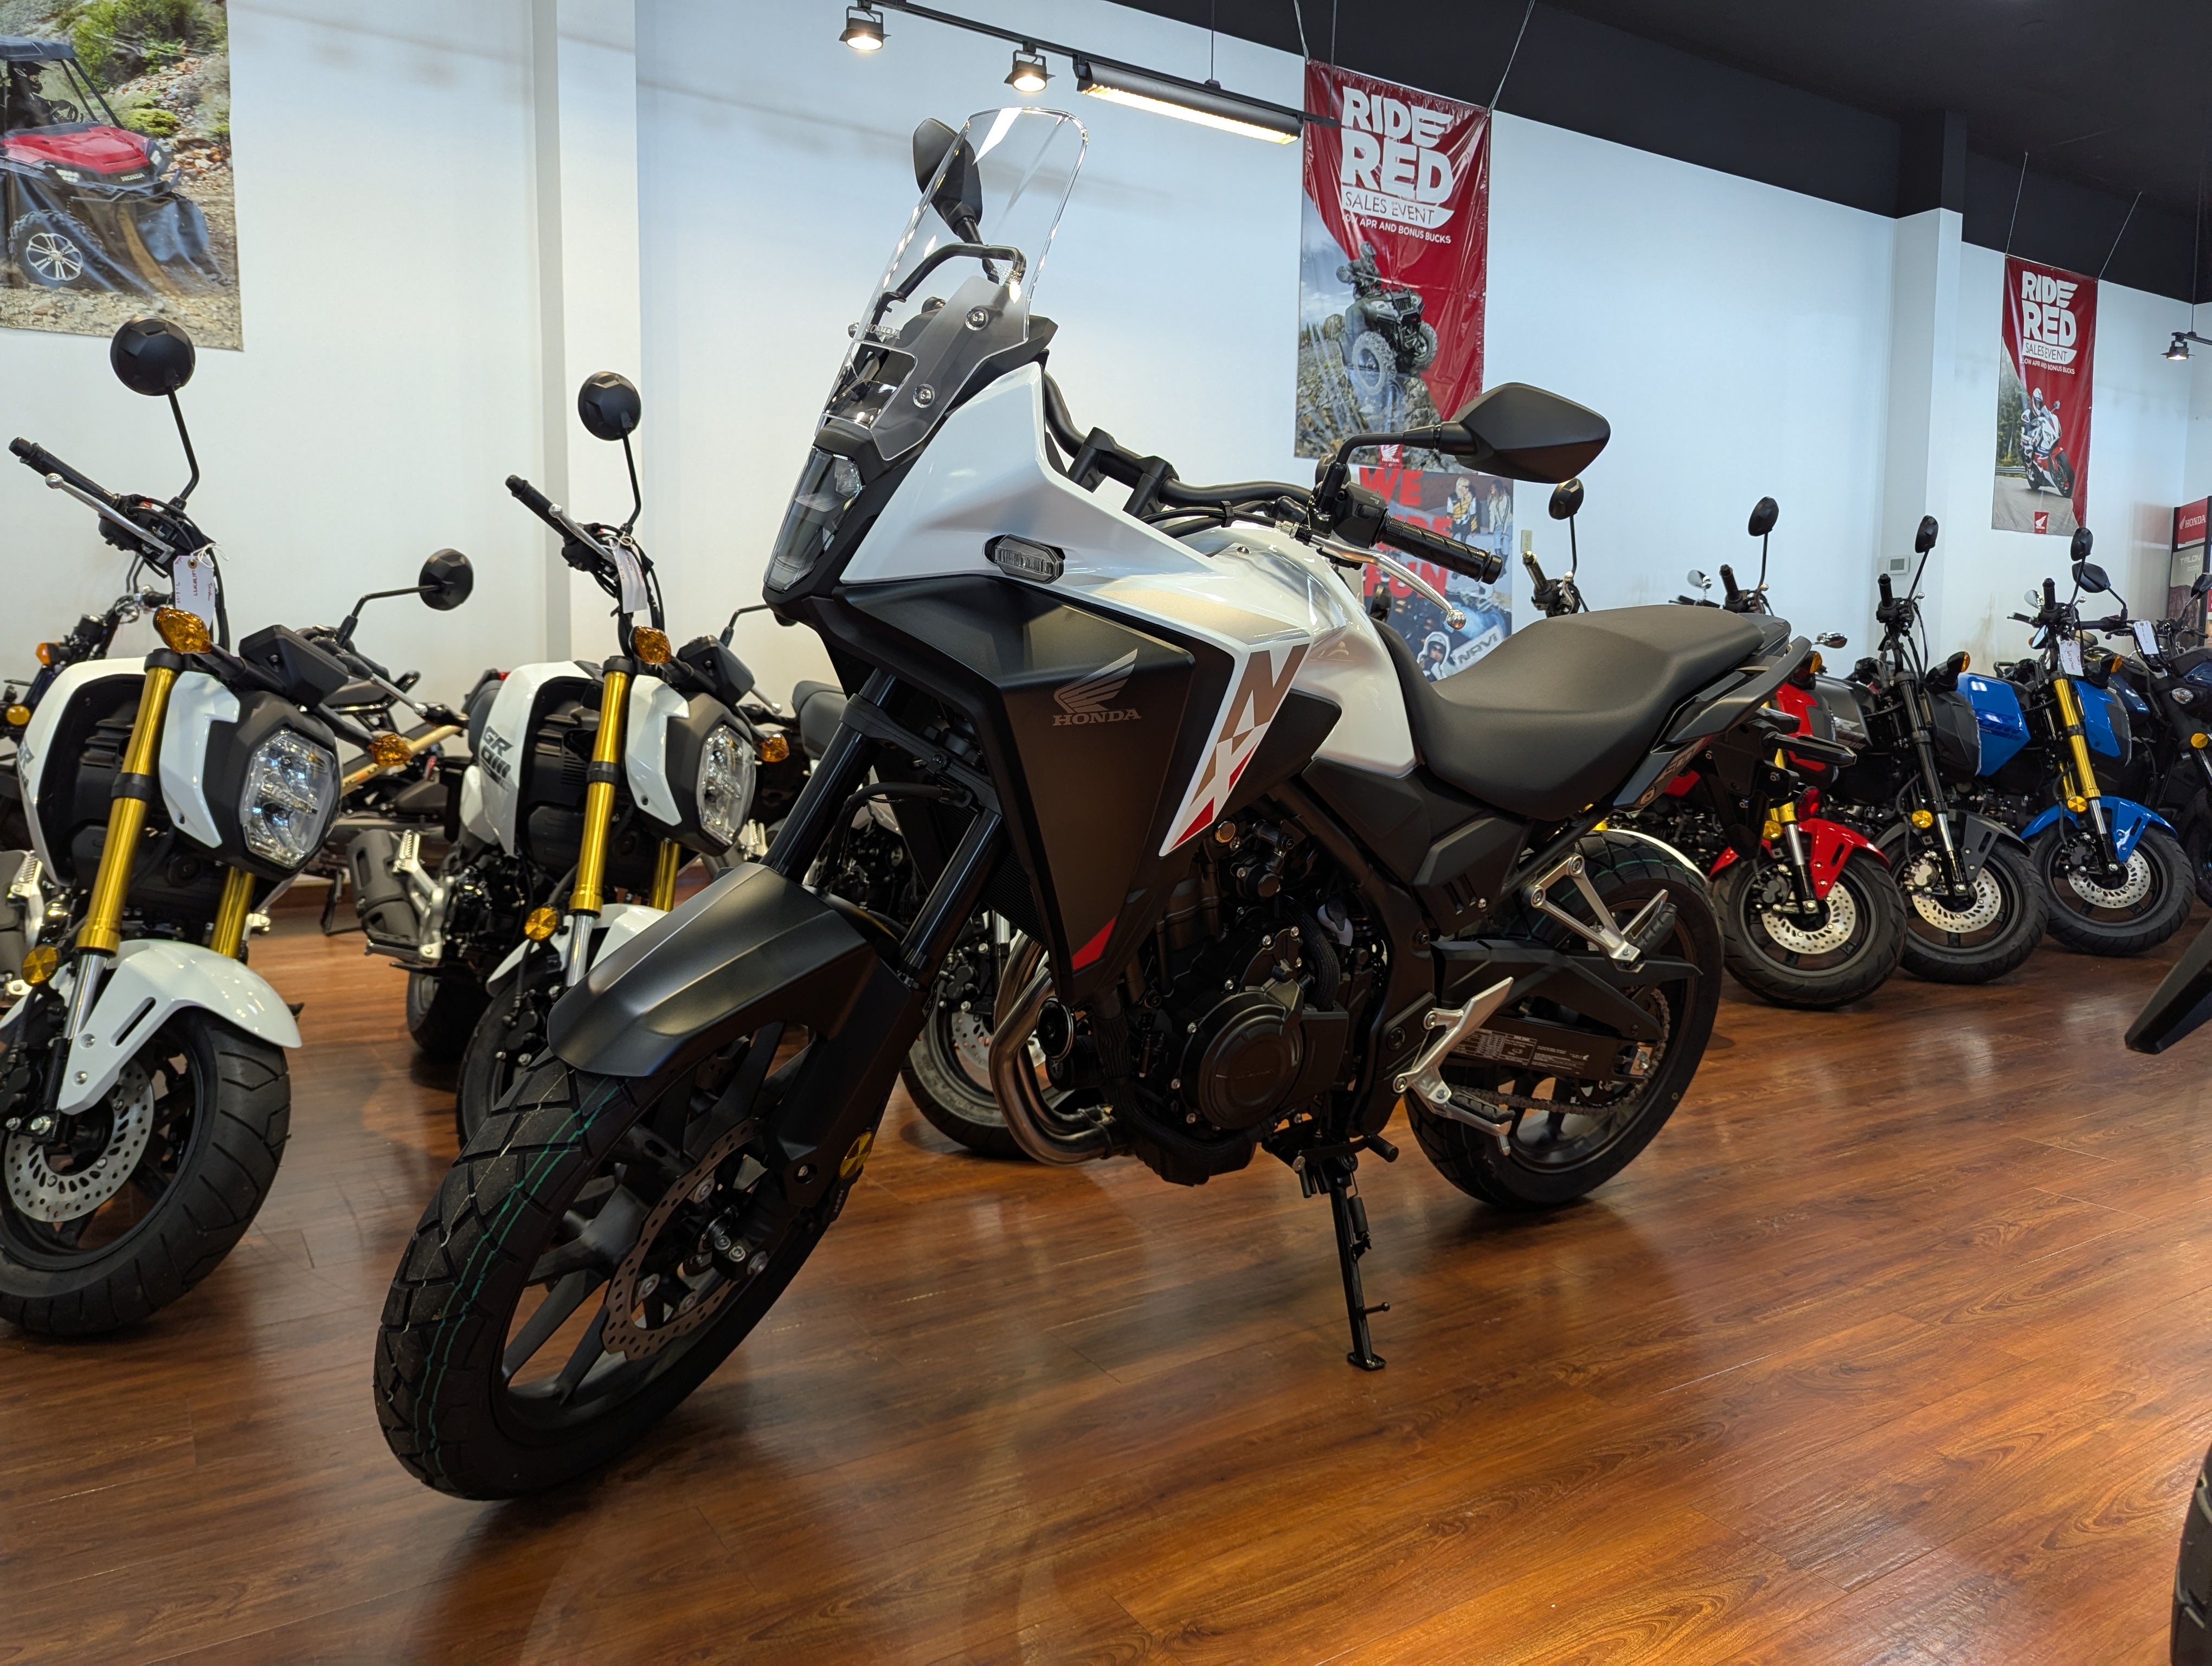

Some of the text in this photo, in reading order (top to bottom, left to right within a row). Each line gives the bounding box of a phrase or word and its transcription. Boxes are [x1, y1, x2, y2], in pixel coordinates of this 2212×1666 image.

[1341, 86, 1453, 148] RIDE
[1341, 128, 1454, 204] RED
[1345, 191, 1435, 225] SALES EVENT
[1360, 218, 1378, 229] APR
[1379, 221, 1397, 233] AND
[1398, 225, 1424, 239] BONUS
[1425, 232, 1451, 244] BUCKS
[2022, 271, 2078, 308] RIDE
[2022, 300, 2076, 347] RED
[2025, 342, 2067, 362] SALES EVENT
[2047, 364, 2062, 372] BONUS
[1360, 467, 1423, 506] WE
[2185, 515, 2206, 528] HONDA
[1052, 708, 1141, 726] HONDA
